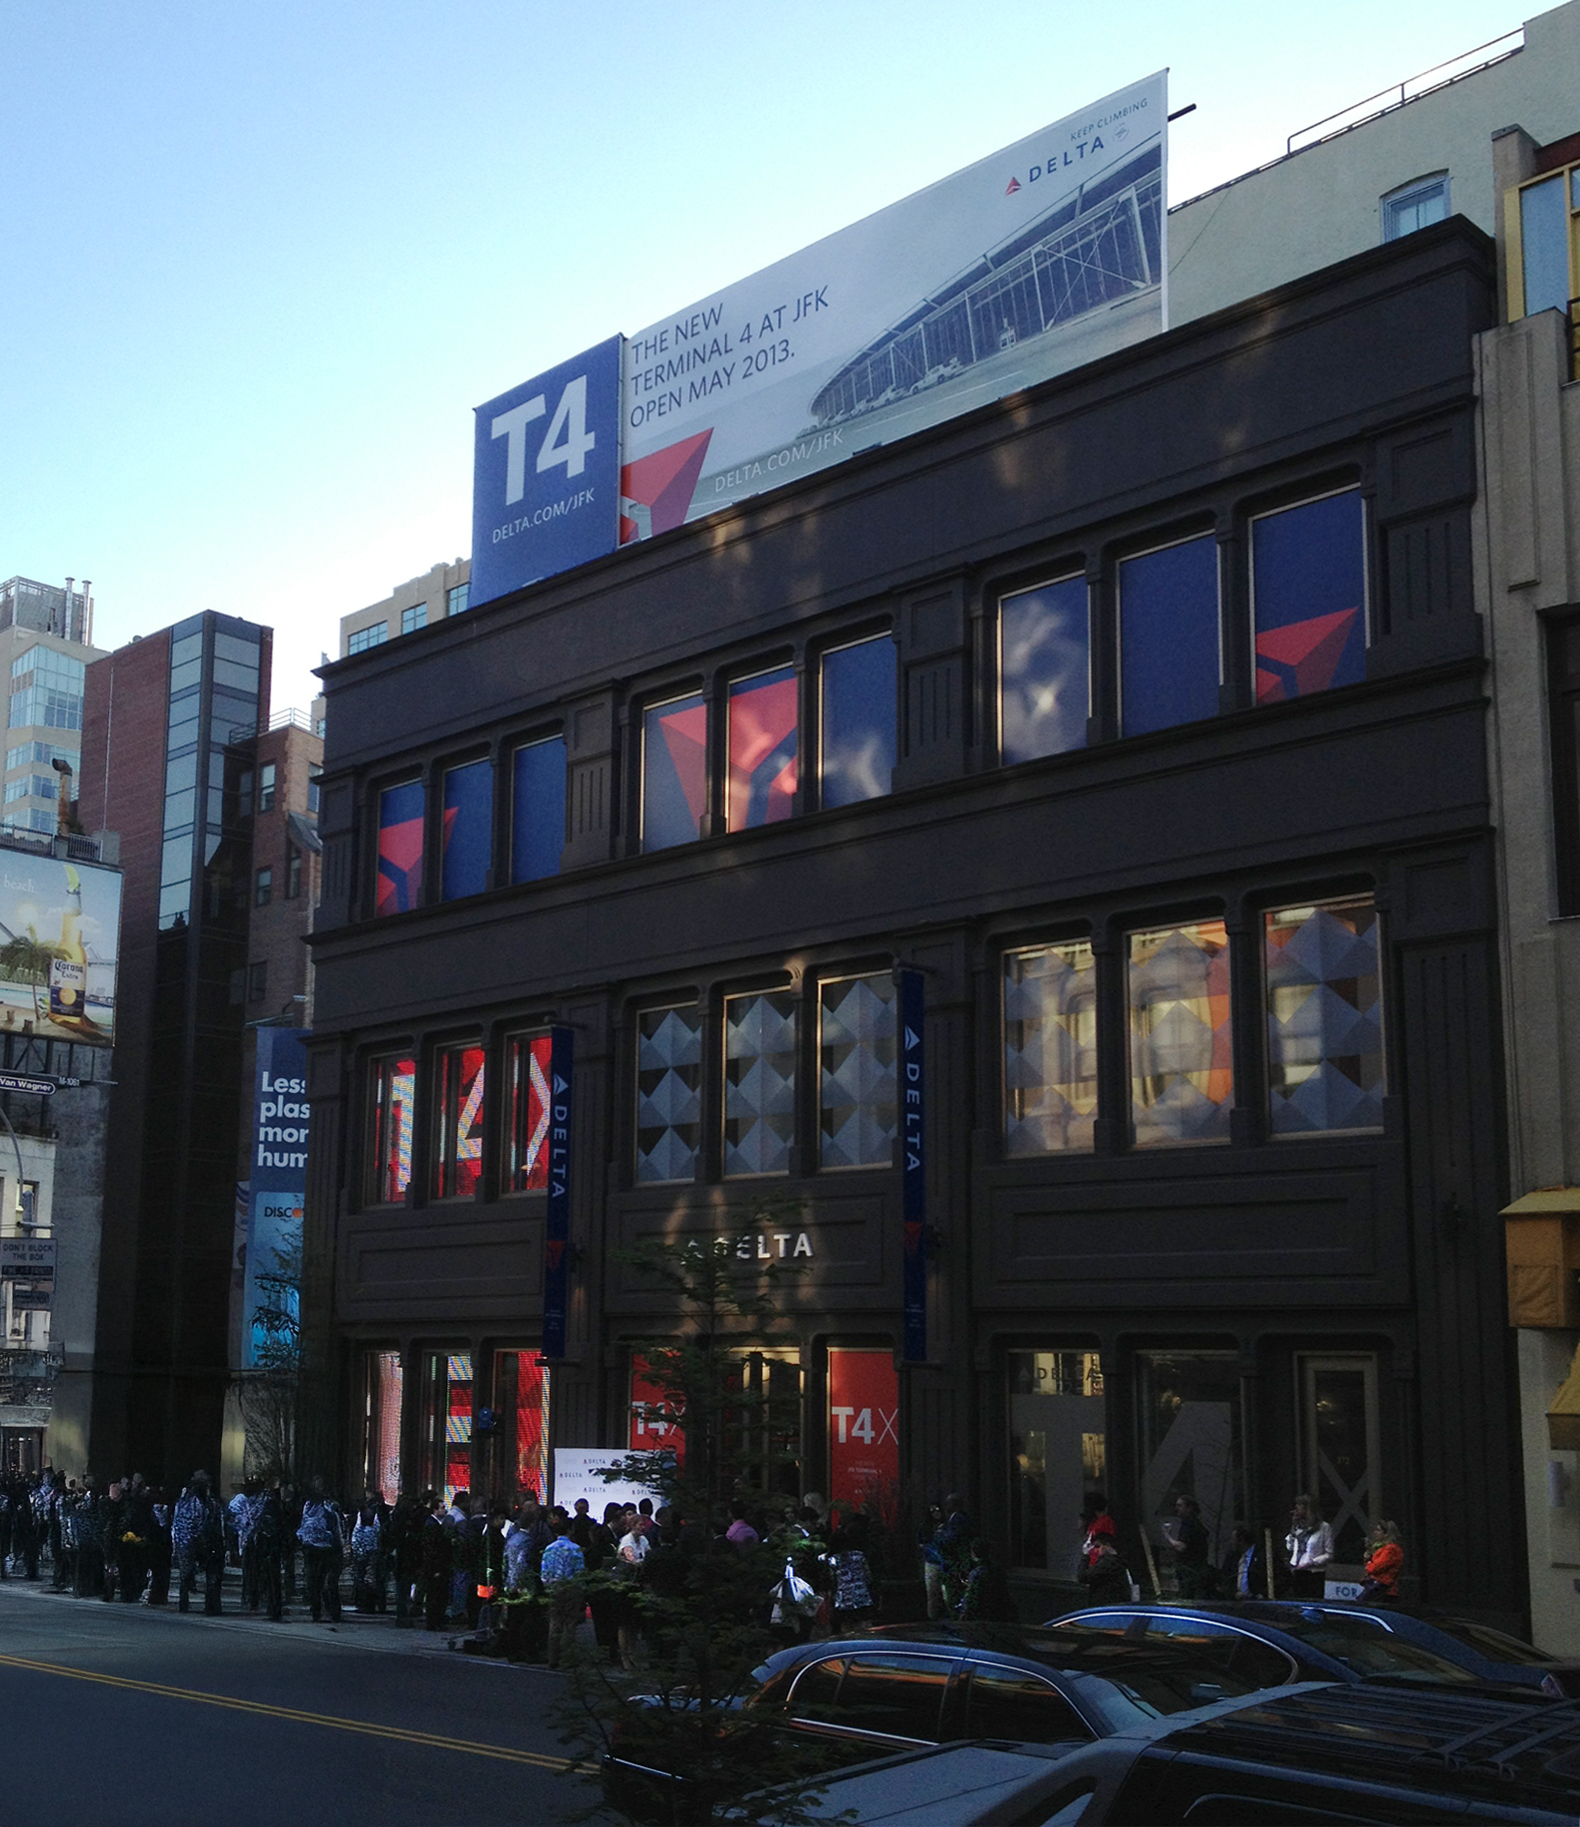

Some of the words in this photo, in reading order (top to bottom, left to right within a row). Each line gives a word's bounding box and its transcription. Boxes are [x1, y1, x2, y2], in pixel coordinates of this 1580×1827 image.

[1070, 124, 1094, 141] KEEP
[1097, 98, 1148, 129] CLIMBING
[1029, 136, 1105, 183] DELTA
[631, 329, 670, 365] THE
[674, 302, 724, 347] NEW
[631, 333, 733, 396] TERMINAL
[739, 322, 753, 344] 4
[758, 305, 787, 339] AT
[792, 284, 830, 322] JFK
[629, 386, 683, 428] OPEN
[688, 363, 736, 403] MAY
[742, 338, 796, 380] 2013.
[491, 374, 596, 507] T4
[714, 427, 844, 493] DELTA.COM/JFK
[492, 487, 595, 544] DELTA.COM/JFK
[55, 960, 83, 973] Corona
[0, 1078, 16, 1087] Van
[18, 1079, 52, 1091] Wagner
[906, 1062, 921, 1171] DELTA
[552, 1105, 568, 1198] DELTA
[13, 1252, 28, 1261] THE
[29, 1253, 45, 1261] BOX
[28, 1244, 54, 1252] BLOCK
[1336, 1586, 1357, 1598] FOR
